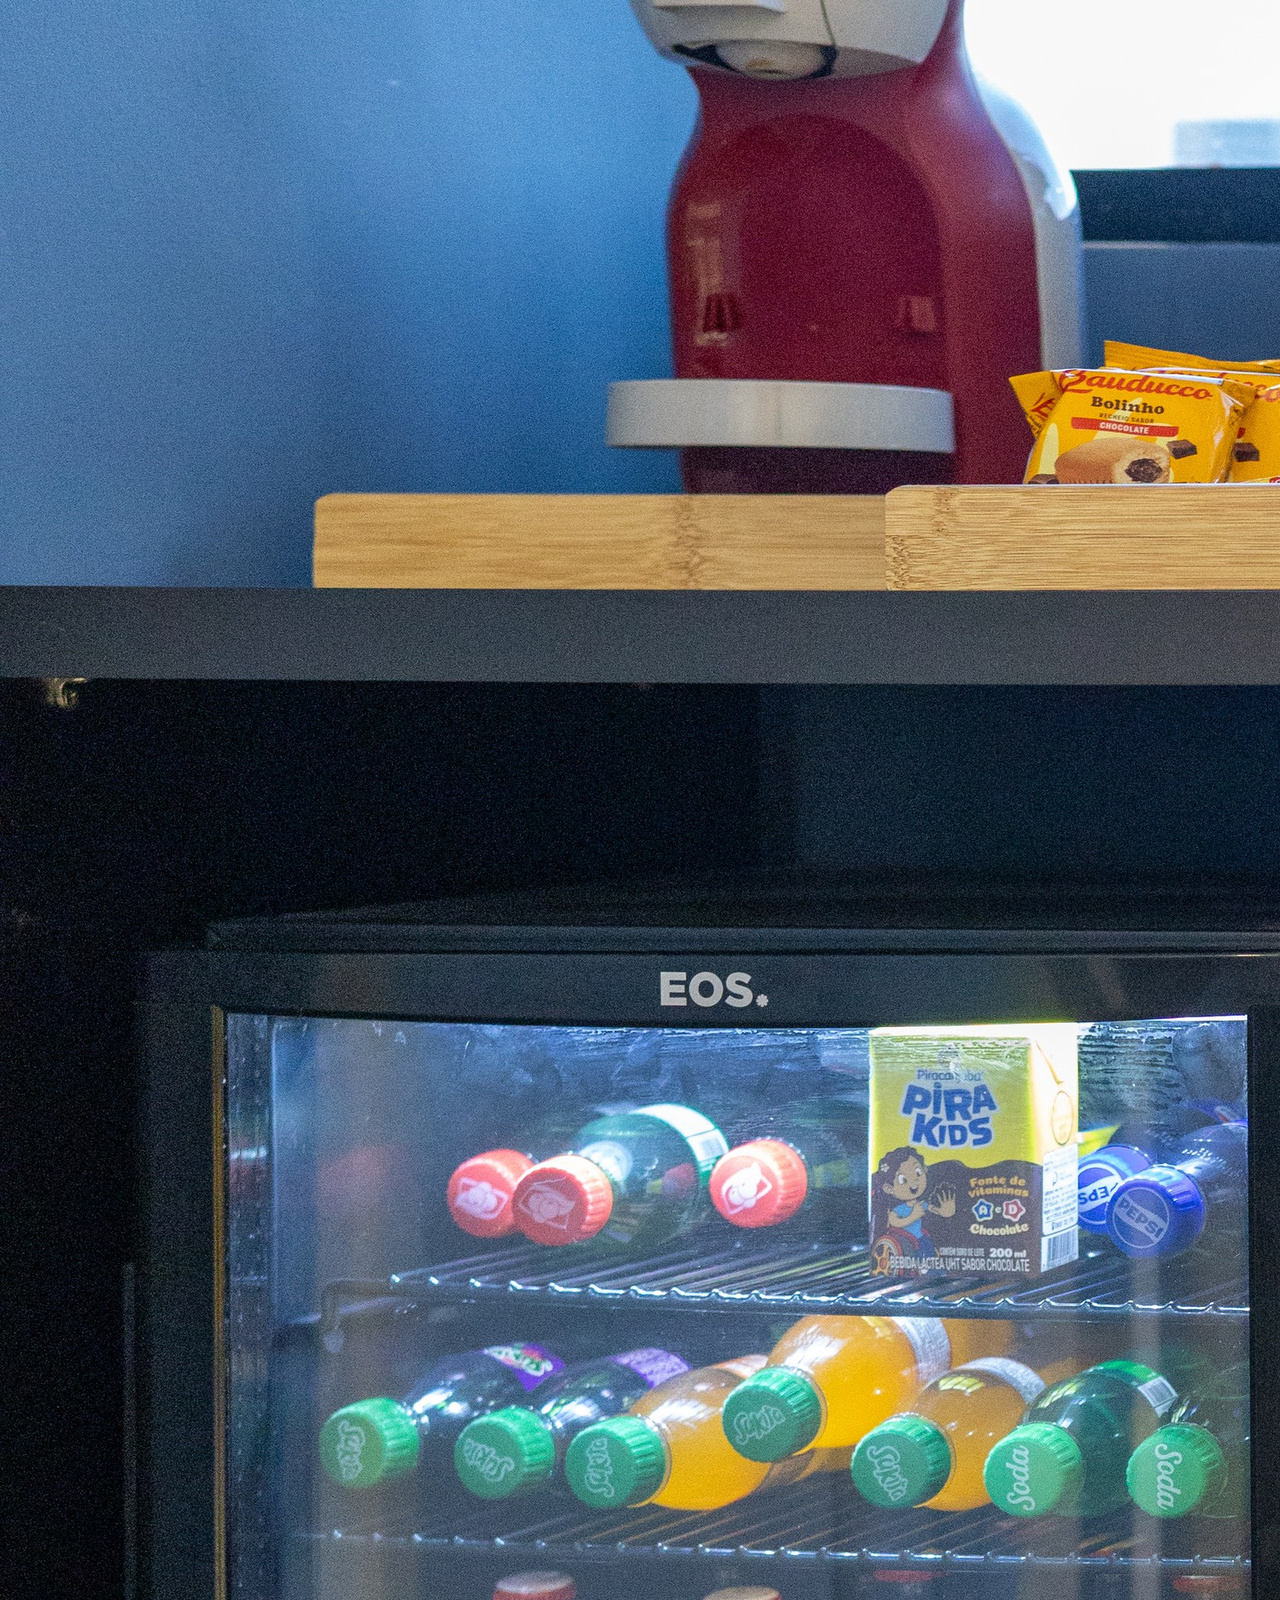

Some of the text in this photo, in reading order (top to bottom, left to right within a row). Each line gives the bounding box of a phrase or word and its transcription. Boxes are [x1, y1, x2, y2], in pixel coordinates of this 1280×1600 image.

[1059, 369, 1213, 400] Bauducco
[1091, 396, 1165, 416] Bolinho
[1099, 421, 1150, 435] CHOCOLATE
[1131, 416, 1155, 424] SABOR
[660, 971, 769, 1008] EOS.
[970, 1175, 1026, 1188] Fonte de
[1117, 1200, 1165, 1240] PEPSI
[968, 1223, 1030, 1236] Chocolate
[989, 1247, 1027, 1258] 200 ml
[946, 1257, 960, 1271] UHT
[961, 1257, 986, 1271] SABOR
[986, 1258, 1030, 1272] CHOCOLATE
[1006, 1444, 1036, 1512] Soda
[1154, 1442, 1183, 1510] Soda
